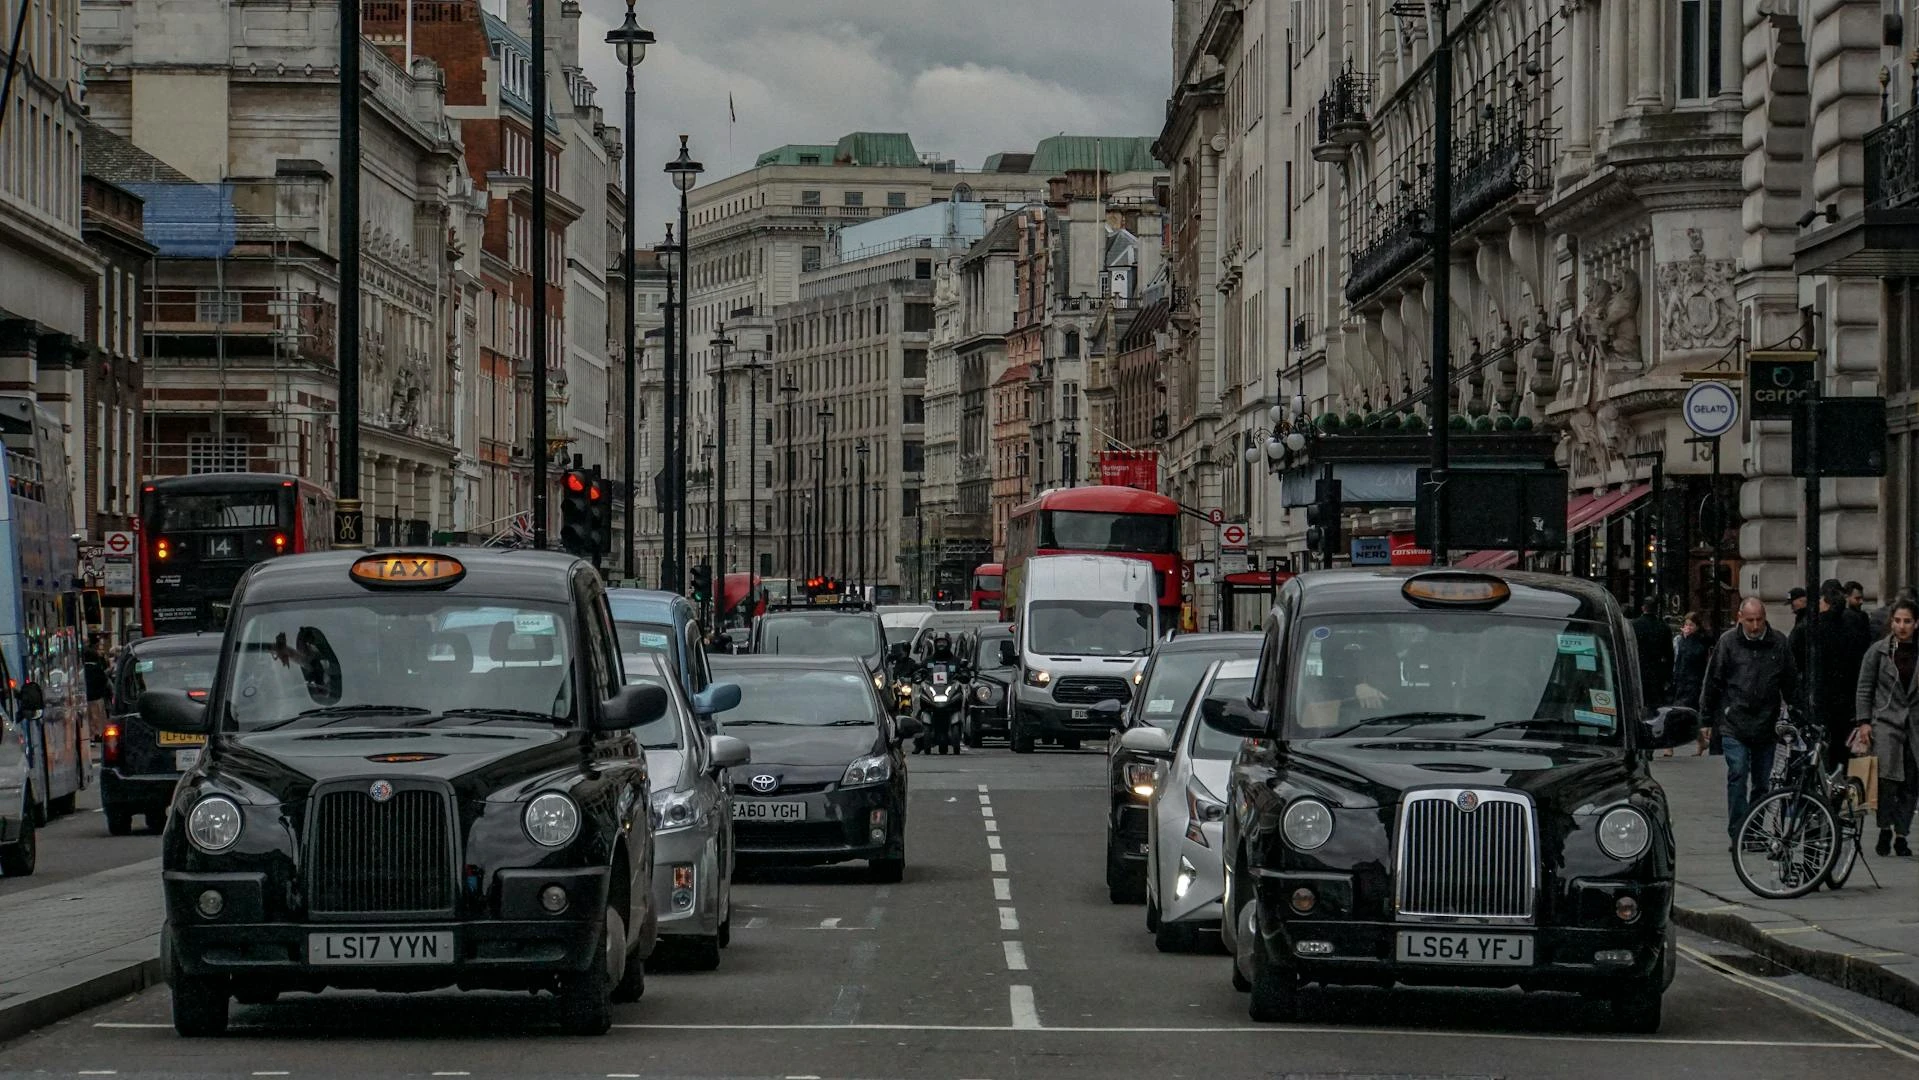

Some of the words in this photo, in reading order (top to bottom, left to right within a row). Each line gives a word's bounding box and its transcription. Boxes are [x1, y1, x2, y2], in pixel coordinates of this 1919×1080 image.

[1693, 404, 1728, 415] GELATO
[1212, 511, 1221, 522] B
[132, 518, 140, 531] S
[210, 537, 232, 556] 14
[1356, 551, 1388, 559] NERO
[376, 560, 440, 578] TAXI
[1751, 574, 1758, 590] H
[936, 674, 945, 682] L
[771, 803, 800, 818] YGH
[326, 936, 381, 959] LS17
[388, 935, 438, 958] YYN
[1407, 935, 1470, 959] LS64
[1478, 937, 1524, 960] YFJ
